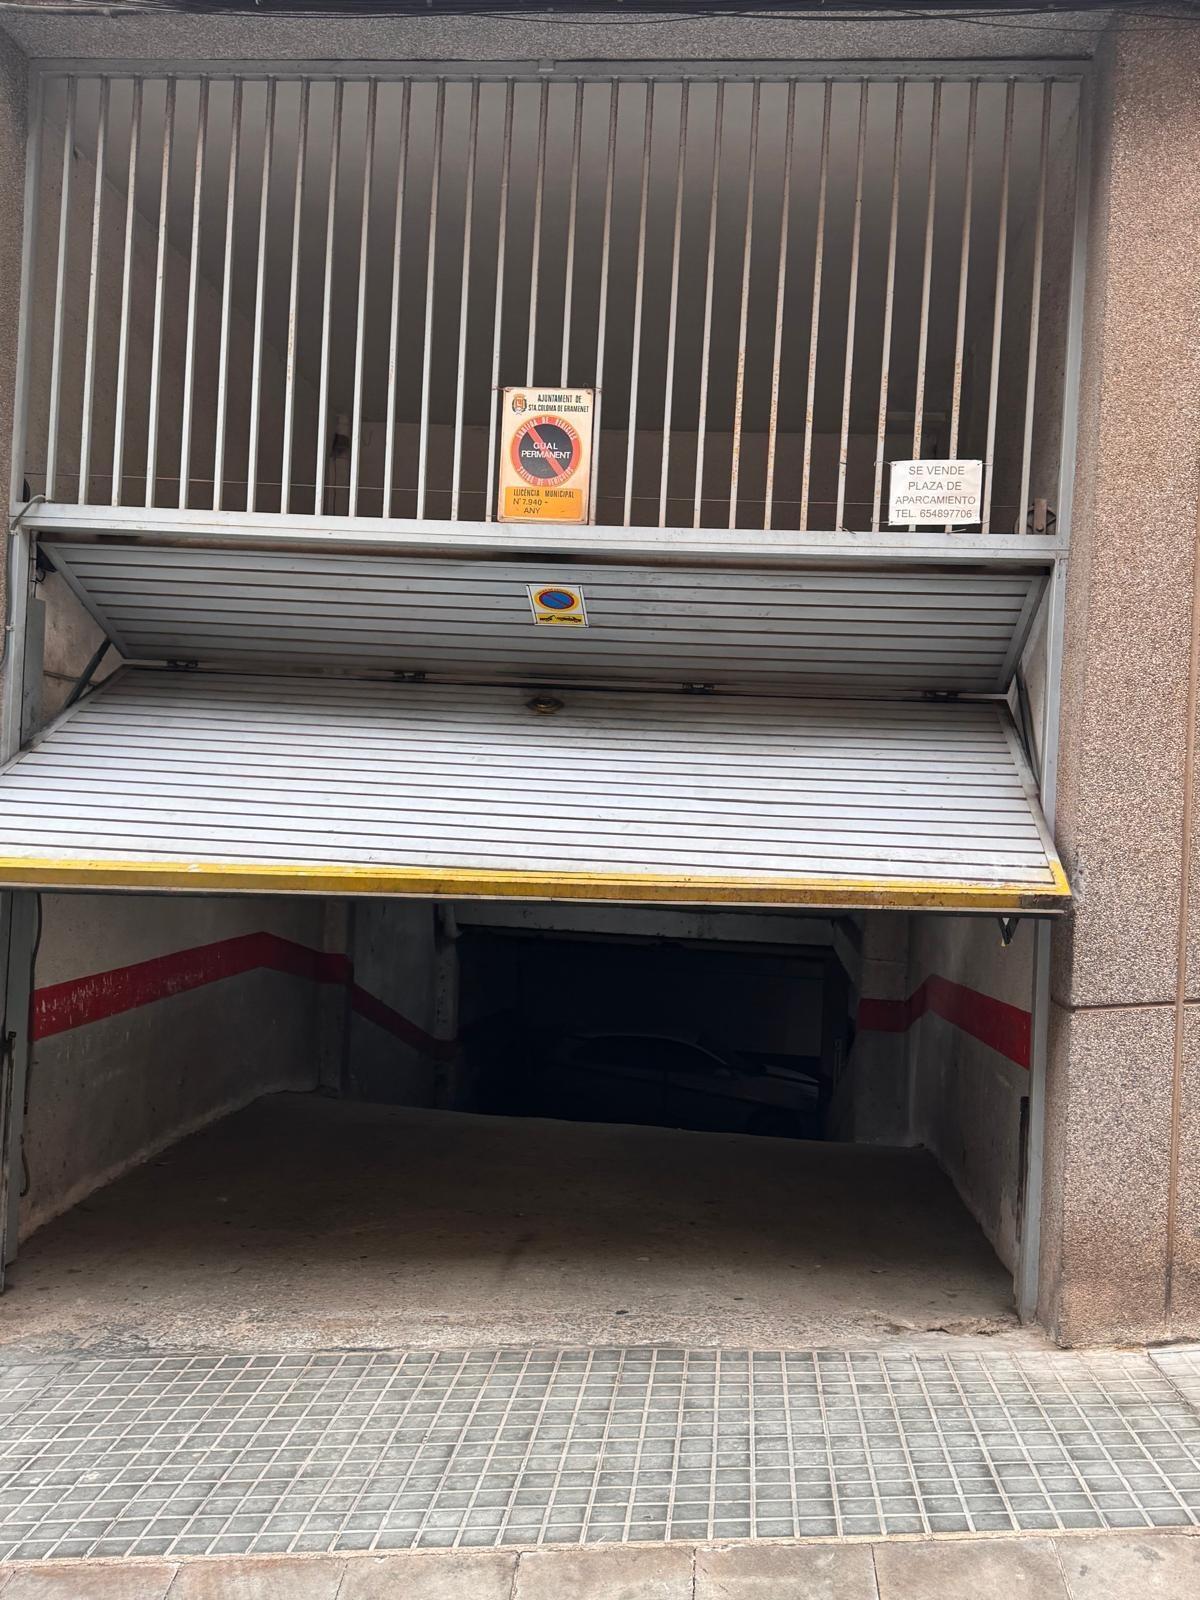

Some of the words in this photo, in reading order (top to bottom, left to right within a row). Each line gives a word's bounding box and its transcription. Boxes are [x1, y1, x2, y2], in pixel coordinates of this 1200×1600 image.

[537, 394, 573, 403] AJUNTAMENT
[575, 395, 582, 403] DE
[564, 405, 589, 413] GRAMENET
[533, 442, 558, 450] GUAL
[521, 450, 571, 459] PERMANENT
[908, 466, 923, 475] SE
[926, 466, 965, 475] VENDE
[908, 481, 944, 491] PLAZA
[946, 481, 962, 491] DE
[544, 490, 575, 498] MUNICIPAL
[522, 498, 543, 506] 7.940
[895, 496, 976, 505] APARCAMIENTO
[895, 509, 916, 518] TEL.
[919, 509, 972, 519] 654897706
